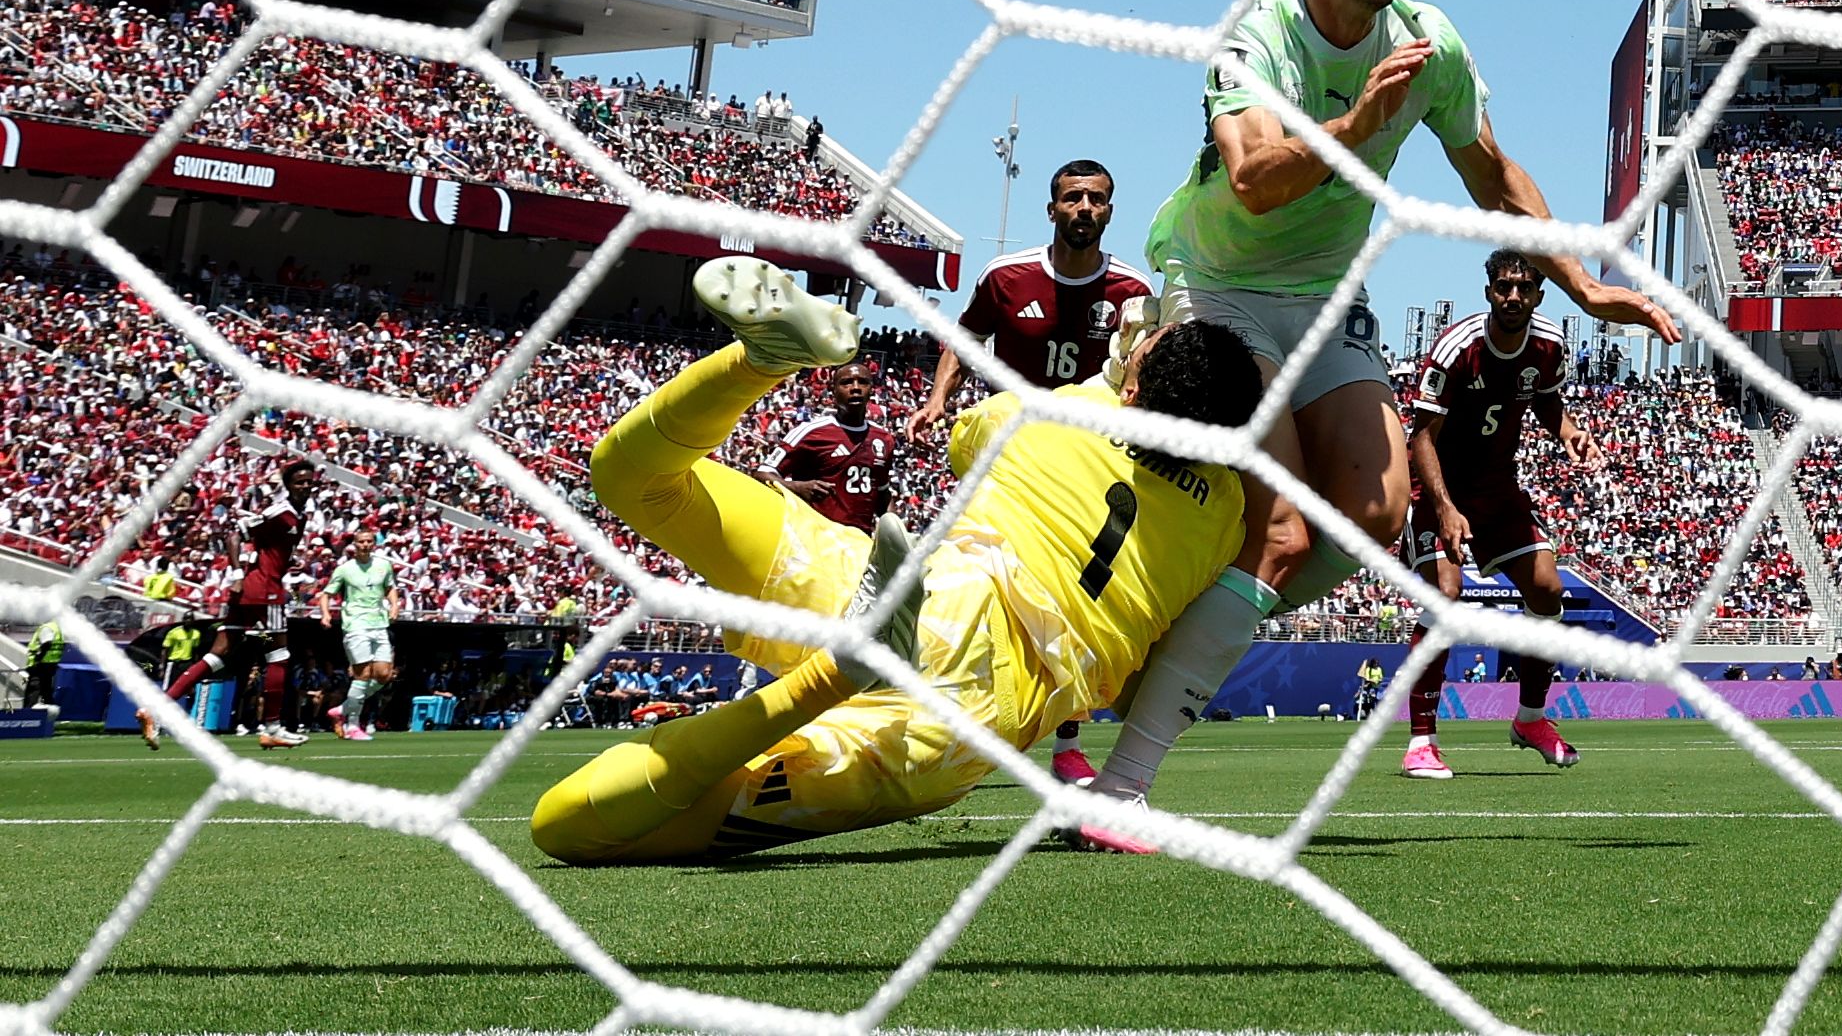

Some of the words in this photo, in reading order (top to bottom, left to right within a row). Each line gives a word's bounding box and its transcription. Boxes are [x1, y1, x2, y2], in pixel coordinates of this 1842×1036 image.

[173, 155, 275, 188] SWITZERLAND
[1045, 340, 1079, 379] 16
[1481, 404, 1502, 436] 5
[845, 465, 871, 494] 23
[1078, 481, 1138, 602] 1
